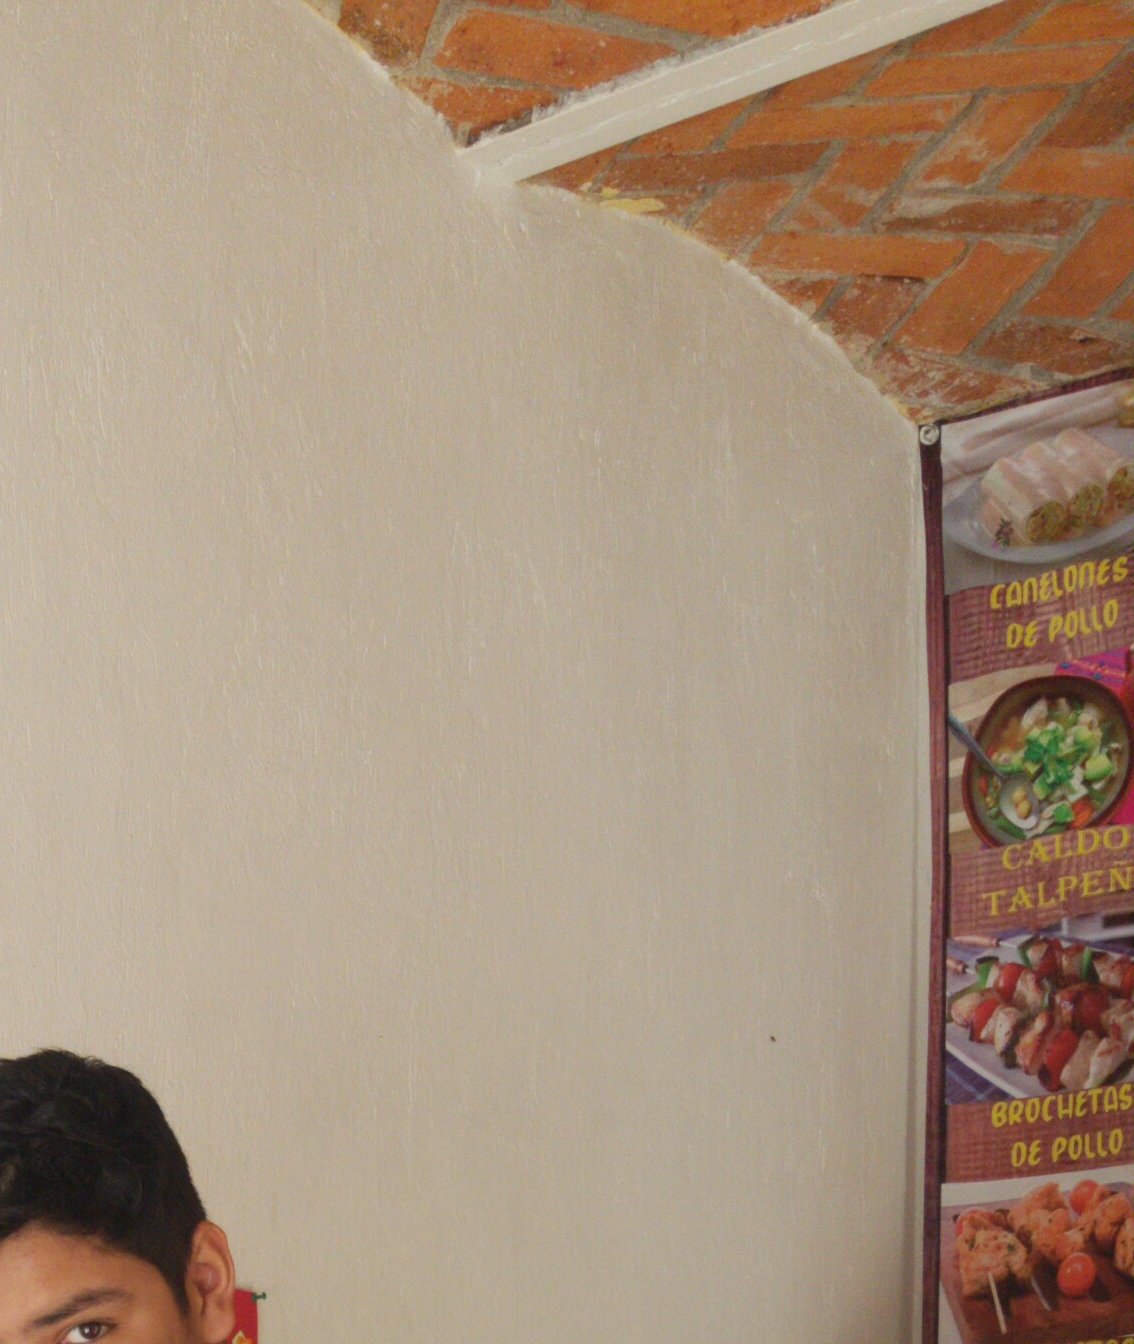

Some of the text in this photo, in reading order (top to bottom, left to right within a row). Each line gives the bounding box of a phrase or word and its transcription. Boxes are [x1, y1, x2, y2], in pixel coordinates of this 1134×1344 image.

[989, 555, 1129, 610] CANELONES
[1006, 598, 1119, 650] DE POLLO
[1001, 824, 1130, 871] CALDO
[990, 1082, 1134, 1128] BROCHETAS
[1010, 1127, 1124, 1169] DE POLLO
